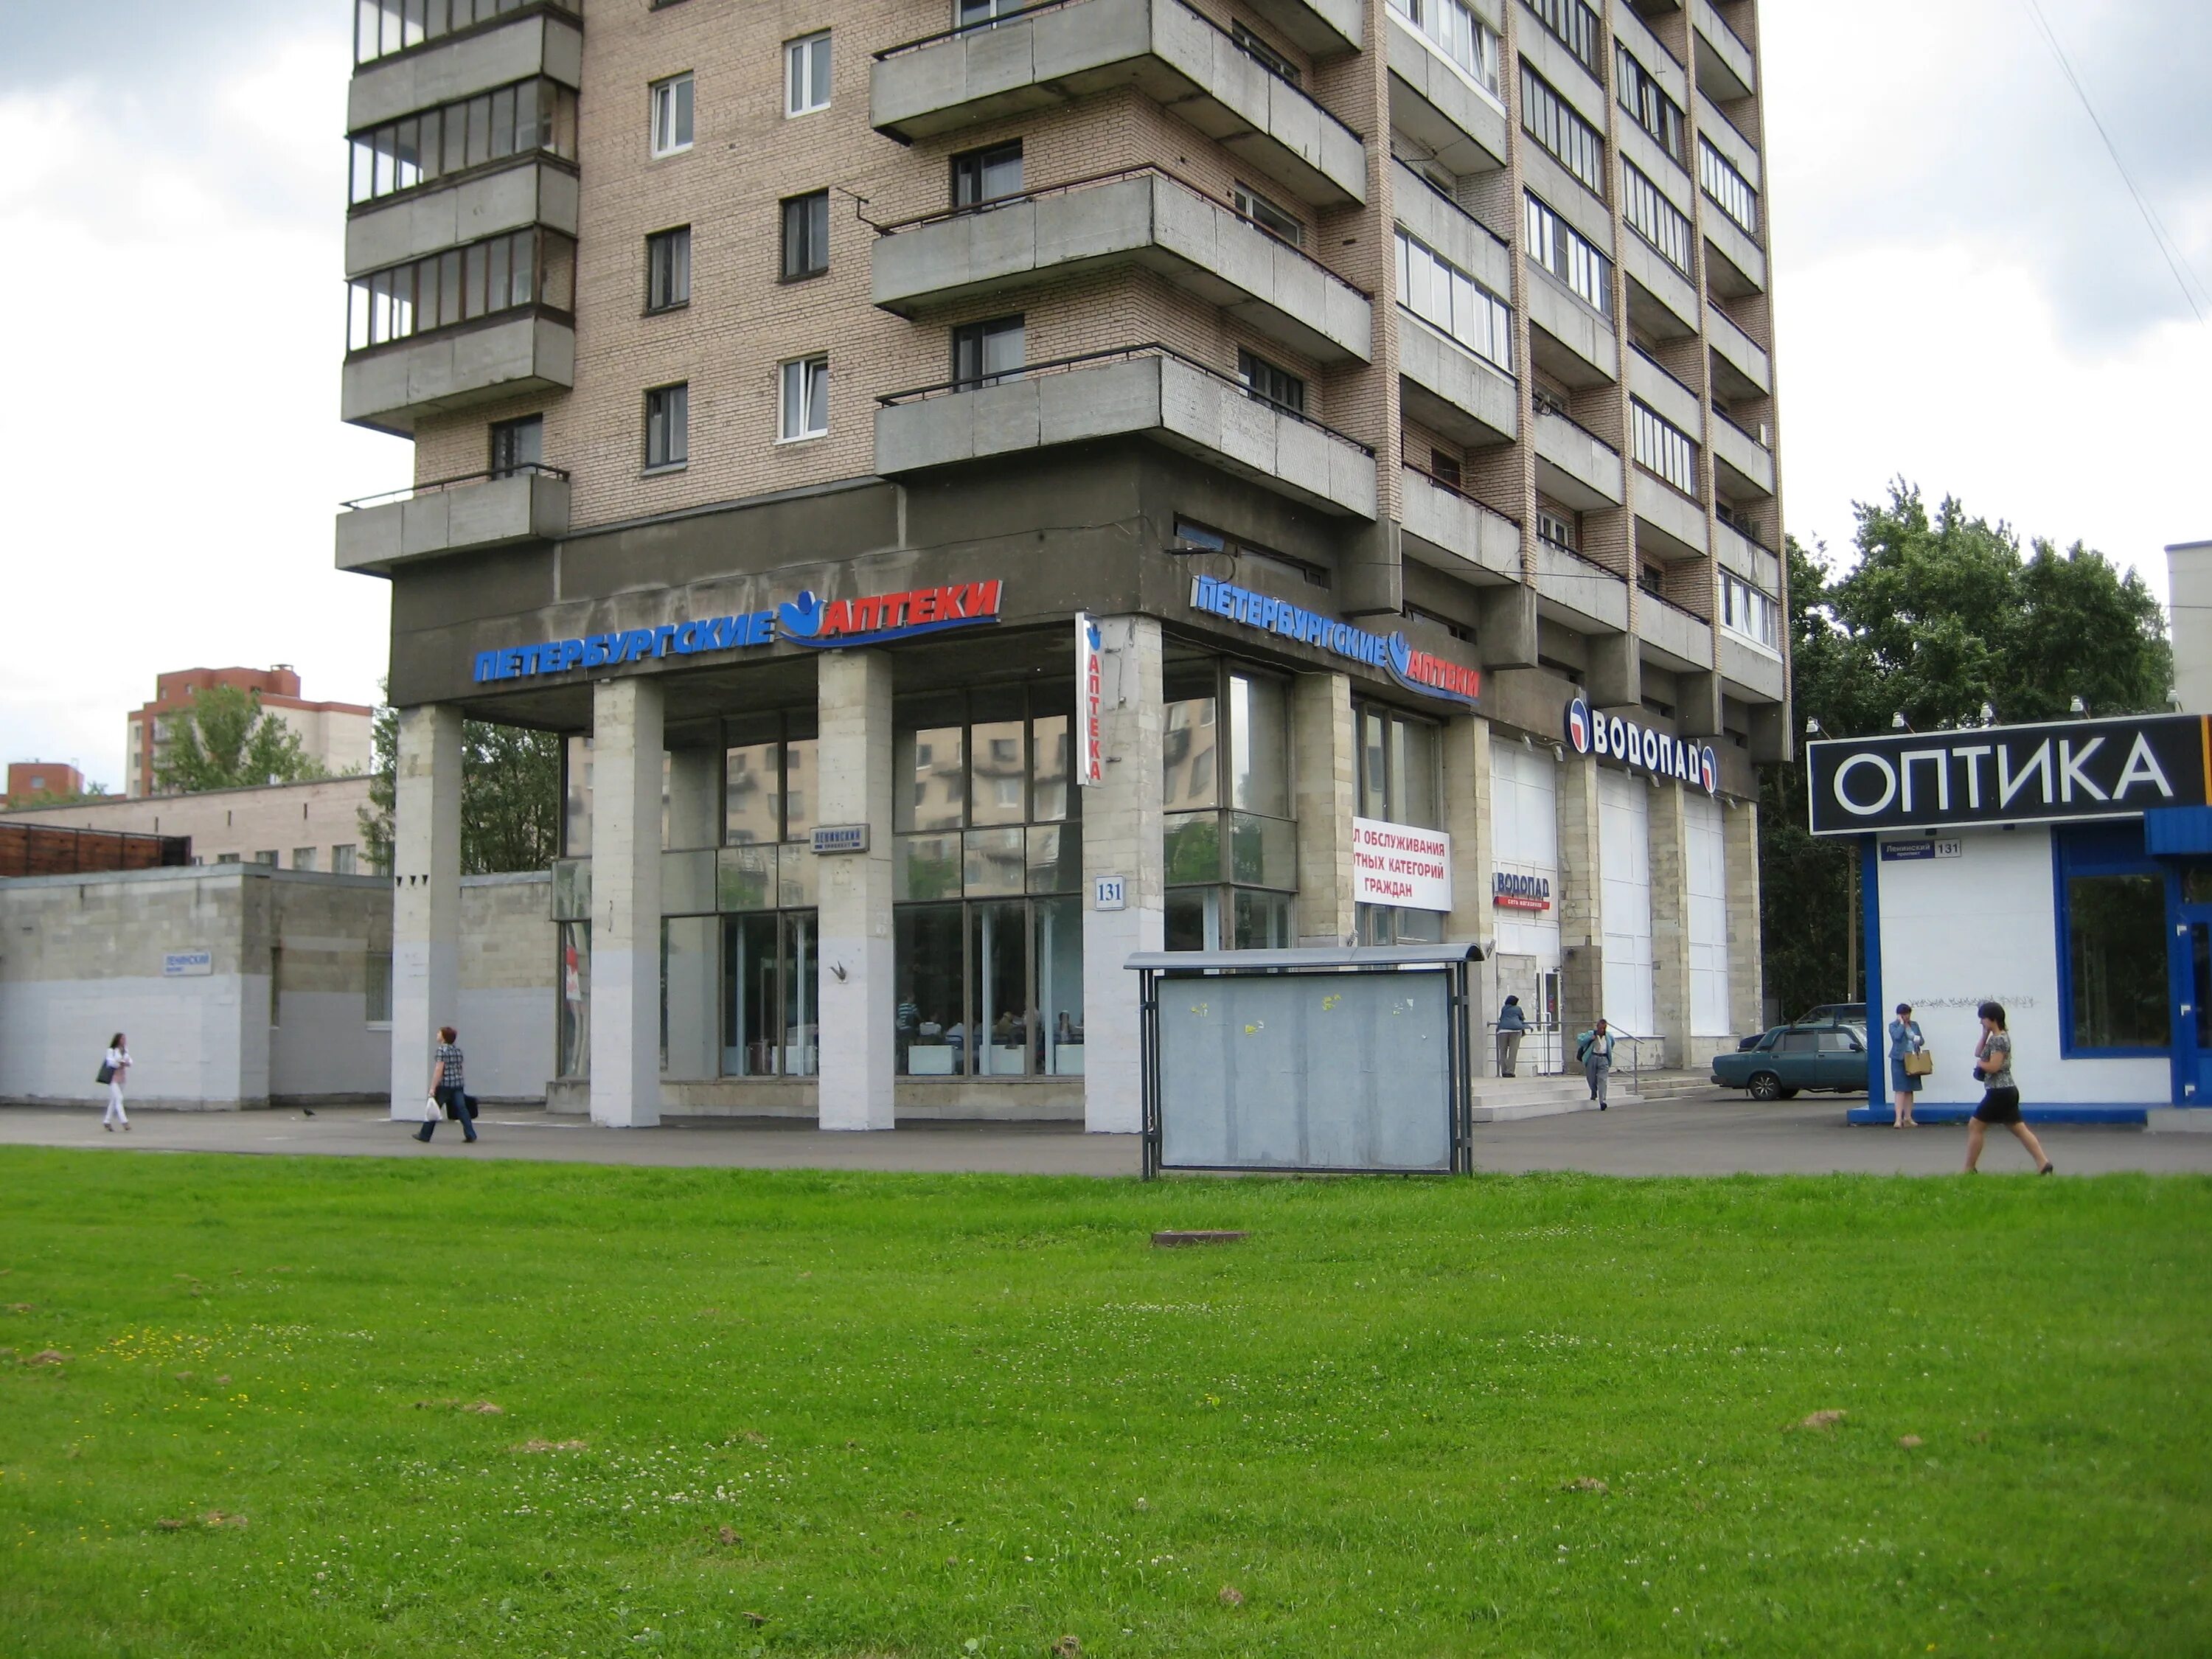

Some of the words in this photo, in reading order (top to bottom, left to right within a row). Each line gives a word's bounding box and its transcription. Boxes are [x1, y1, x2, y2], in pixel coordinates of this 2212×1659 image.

[474, 609, 776, 683] ПЕТЕРБУРГСКИЕ
[819, 579, 1003, 636] АПТЕКИ
[1192, 574, 1387, 667] ПЕТЕРБУРГСКИЕ
[1404, 649, 1481, 698] АПТЕКИ
[1088, 654, 1102, 780] АПТЕКА
[1591, 709, 1700, 785] ВОДОПАД
[1833, 731, 2174, 816] ОПТИКА
[1364, 830, 1445, 857] ОБСЛУЖИВАНИЯ
[1887, 844, 1930, 852] Ленинский
[1938, 844, 1958, 854] 131
[1388, 858, 1444, 880] КАТЕГОРИЙ
[1098, 883, 1121, 900] 131
[1364, 877, 1413, 898] ГРАЖДАН
[1497, 872, 1550, 897] ВОДОПАД
